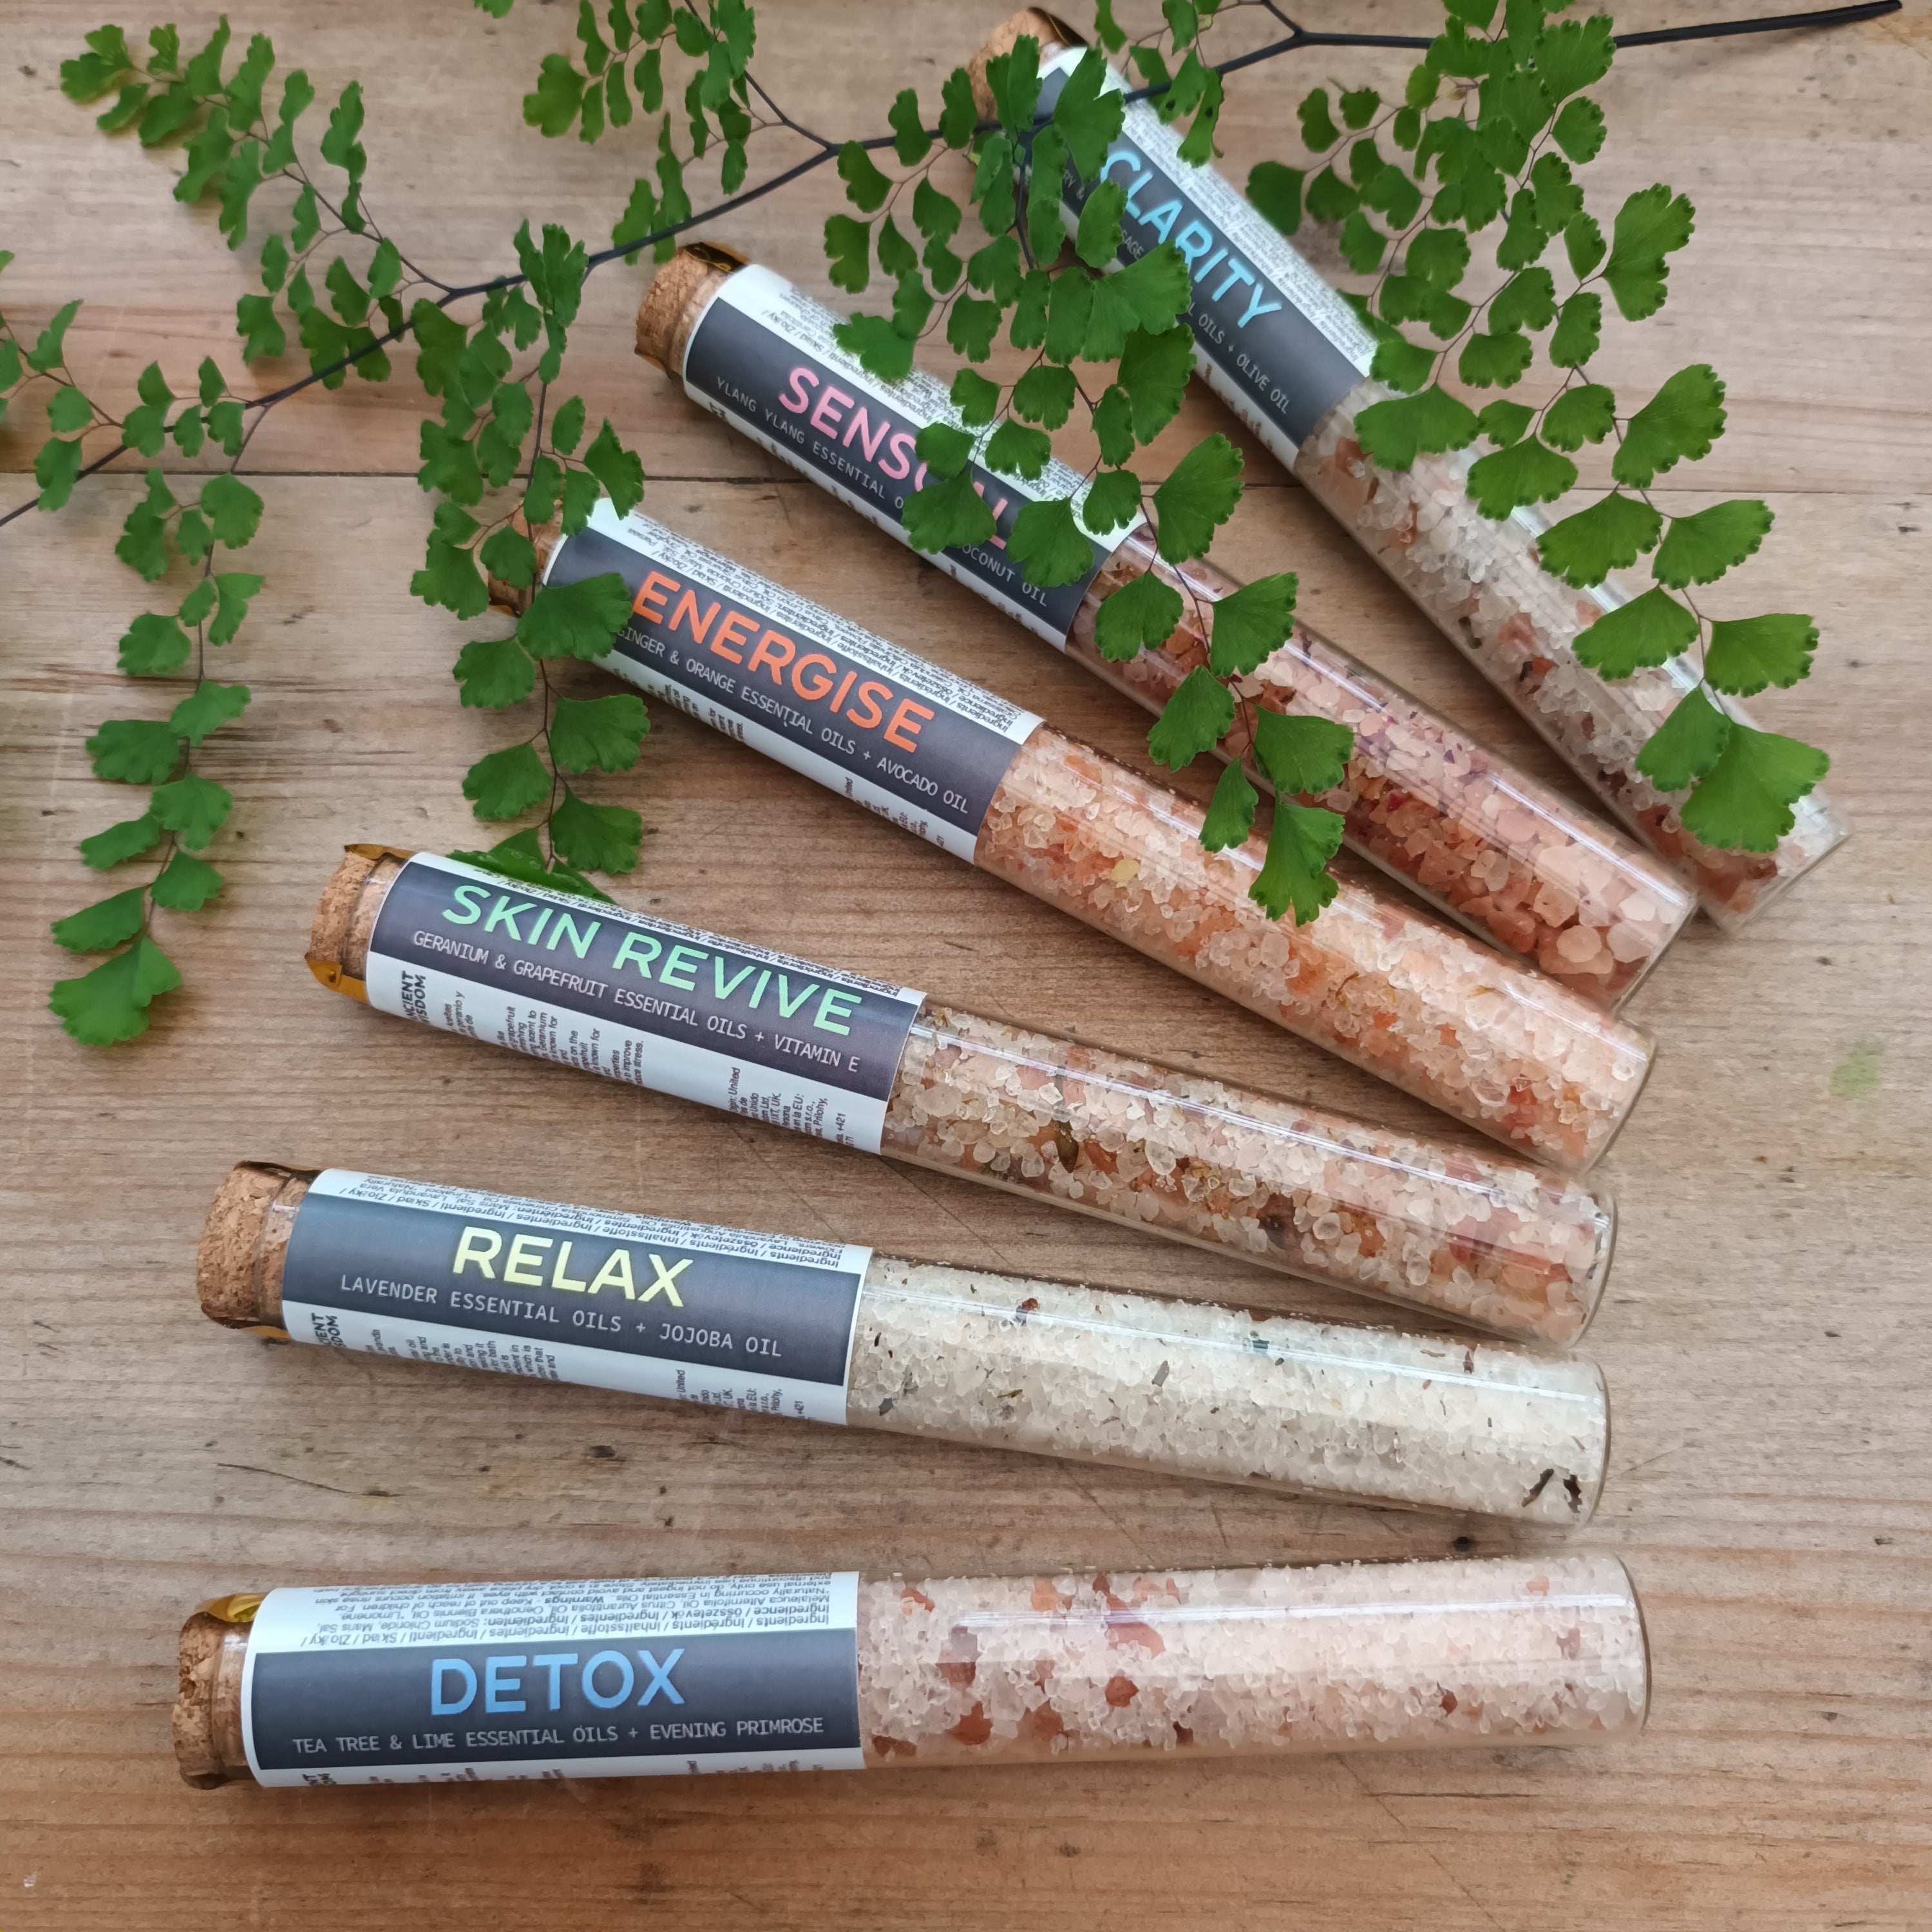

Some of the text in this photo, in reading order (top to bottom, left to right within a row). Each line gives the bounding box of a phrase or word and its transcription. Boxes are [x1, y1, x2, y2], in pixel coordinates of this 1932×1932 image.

[1099, 149, 1282, 328] CLARITY
[1198, 313, 1225, 344] OILS
[1236, 353, 1270, 392] OLIVE
[1270, 388, 1289, 414] OIL
[717, 376, 757, 412] YLANG
[765, 408, 805, 444] YLANG
[813, 440, 885, 499] ESSENTIAL
[779, 368, 1009, 551] SENSL
[962, 542, 1016, 582] OCONUT
[1022, 582, 1046, 607] OIL
[633, 571, 934, 753] ENERGISE
[669, 650, 679, 665] &
[686, 658, 736, 694] ORANGE
[741, 685, 813, 735] ESSENTIAL
[821, 727, 856, 755] OILS
[863, 751, 871, 760] +
[876, 757, 938, 796] AVOCADO
[943, 790, 968, 814] OIL
[442, 885, 862, 1036] SKIN REVIVE
[413, 930, 861, 1072] GERANIUM & GRAPEFRUIT ESSENTIAL OILS + VITAMIN E
[506, 1006, 518, 1044] grapefruit
[730, 1066, 739, 1095] United
[516, 1213, 593, 1232] Ingredientes
[604, 1220, 680, 1236] Ingredientes
[768, 1244, 841, 1260] Ingredience
[770, 1251, 839, 1268] Ingredients
[452, 1228, 694, 1308] RELAX
[341, 1274, 782, 1357] LAVENDER ESSENTIAL OILS + JOJOBA OIL
[544, 1595, 604, 1604] Warnings
[571, 1602, 638, 1613] Aurantifolia
[641, 1600, 676, 1611] Citrus
[703, 1597, 766, 1607] Alternifolia
[753, 1602, 829, 1615] Ingredience
[769, 1595, 830, 1604] Melaleuca
[433, 1608, 478, 1617] Biennis
[579, 1609, 659, 1623] Ingredientes
[756, 1614, 829, 1627] Ingredients
[341, 1623, 374, 1633] Maris
[434, 1618, 480, 1629] Sodium
[489, 1622, 570, 1639] Ingredientes
[430, 1647, 685, 1716] DETOX
[292, 1717, 824, 1754] TEA TREE & LIME ESSENTIAL OILS + EVENING PRIMROSE
